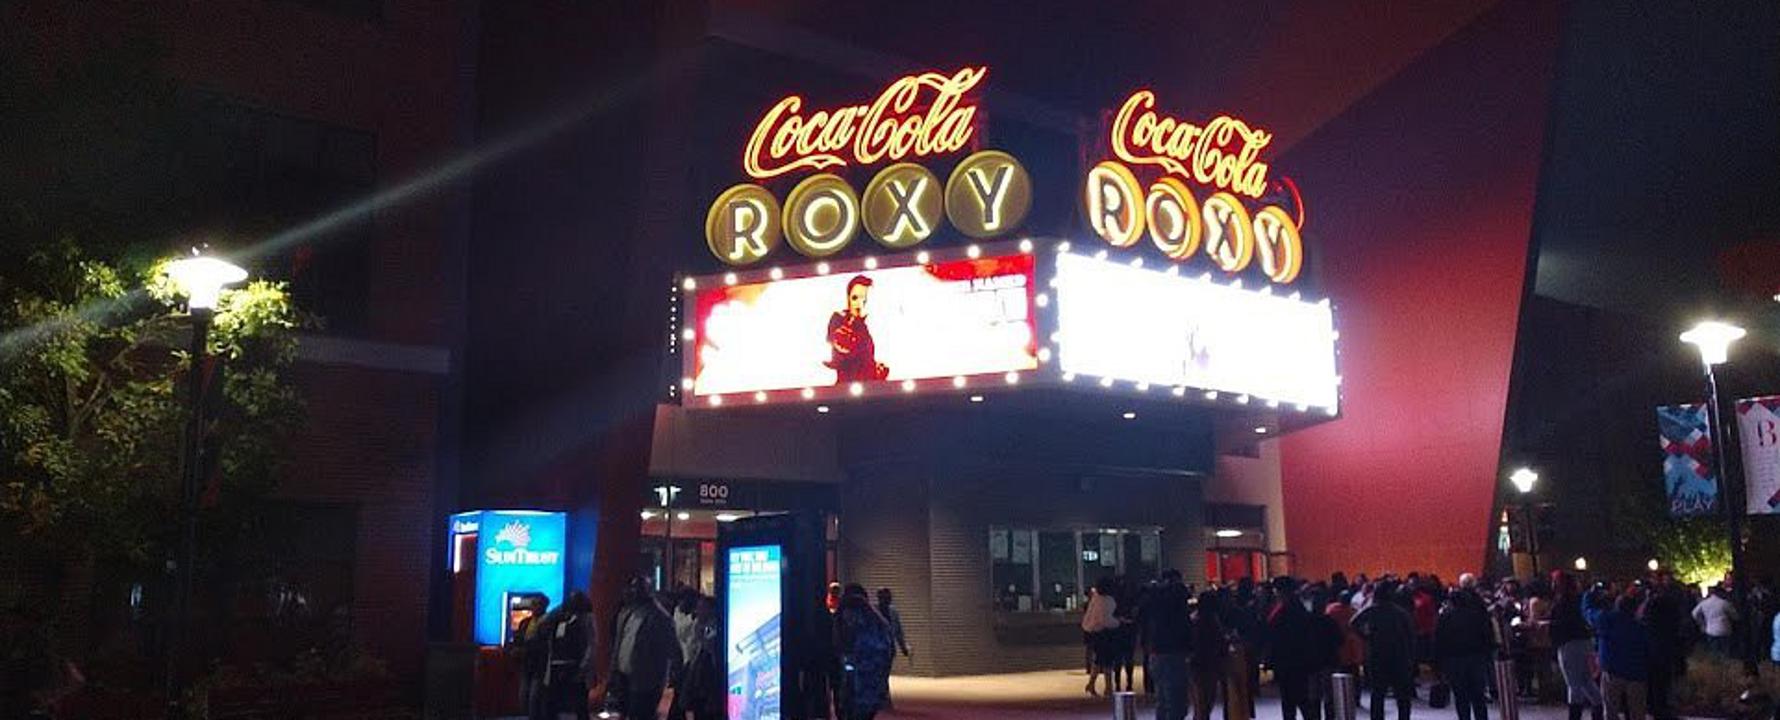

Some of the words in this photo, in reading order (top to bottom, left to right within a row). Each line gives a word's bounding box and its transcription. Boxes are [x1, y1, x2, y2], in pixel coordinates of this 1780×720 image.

[744, 65, 987, 179] Coca-Cola
[1111, 90, 1273, 198] Coca-Cola
[728, 164, 1015, 260] ROXY
[1088, 166, 1285, 281] ROXY
[699, 484, 729, 498] 800
